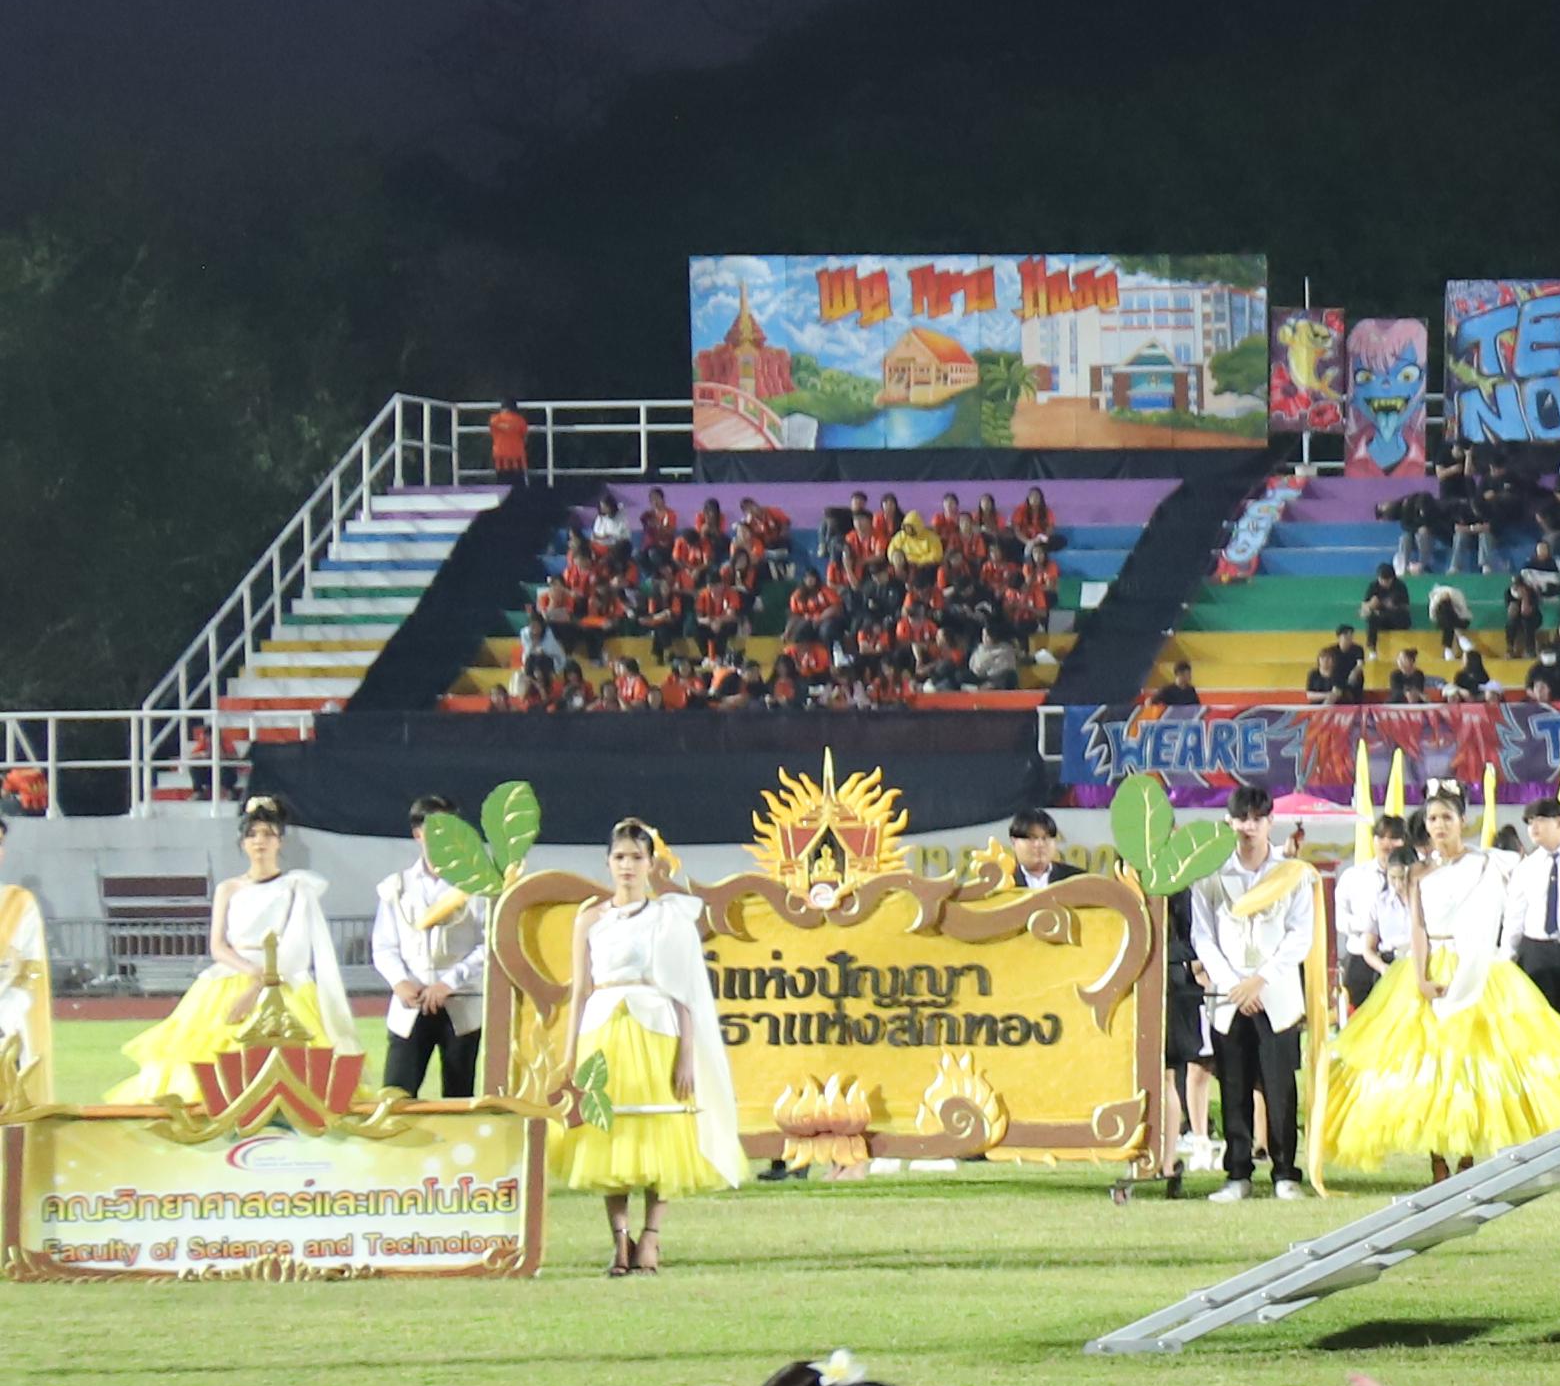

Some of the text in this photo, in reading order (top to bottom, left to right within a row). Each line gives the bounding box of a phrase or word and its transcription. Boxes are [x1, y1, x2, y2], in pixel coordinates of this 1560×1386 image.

[42, 1177, 518, 1222] คณะวิทยาศาสตร์และเทคโนโลยี
[43, 1236, 141, 1264] Faculty
[151, 1236, 178, 1260] of
[187, 1235, 292, 1260] Science
[304, 1233, 354, 1258] and
